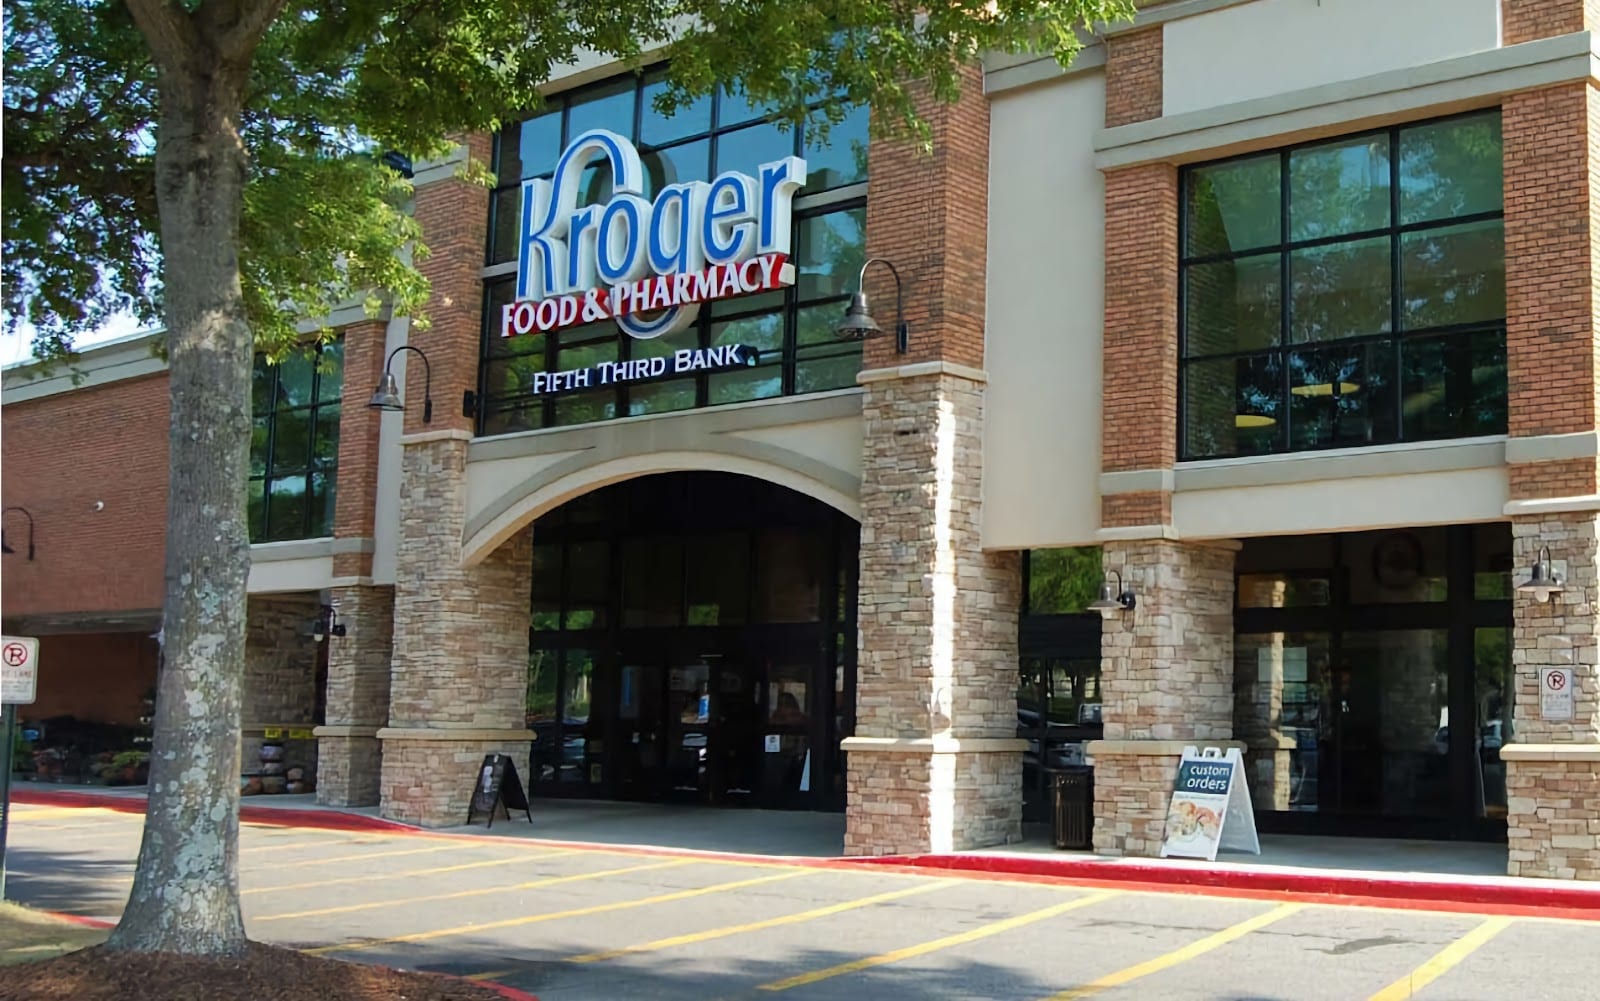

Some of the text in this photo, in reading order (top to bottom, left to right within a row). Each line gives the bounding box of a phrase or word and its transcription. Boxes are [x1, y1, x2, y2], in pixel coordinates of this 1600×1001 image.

[516, 128, 807, 339] Kroger
[501, 254, 780, 338] FOOD & PHARMACY
[533, 343, 744, 395] FIFTH THIRD BANK
[1187, 776, 1227, 790] orders
[1190, 765, 1230, 776] custom
